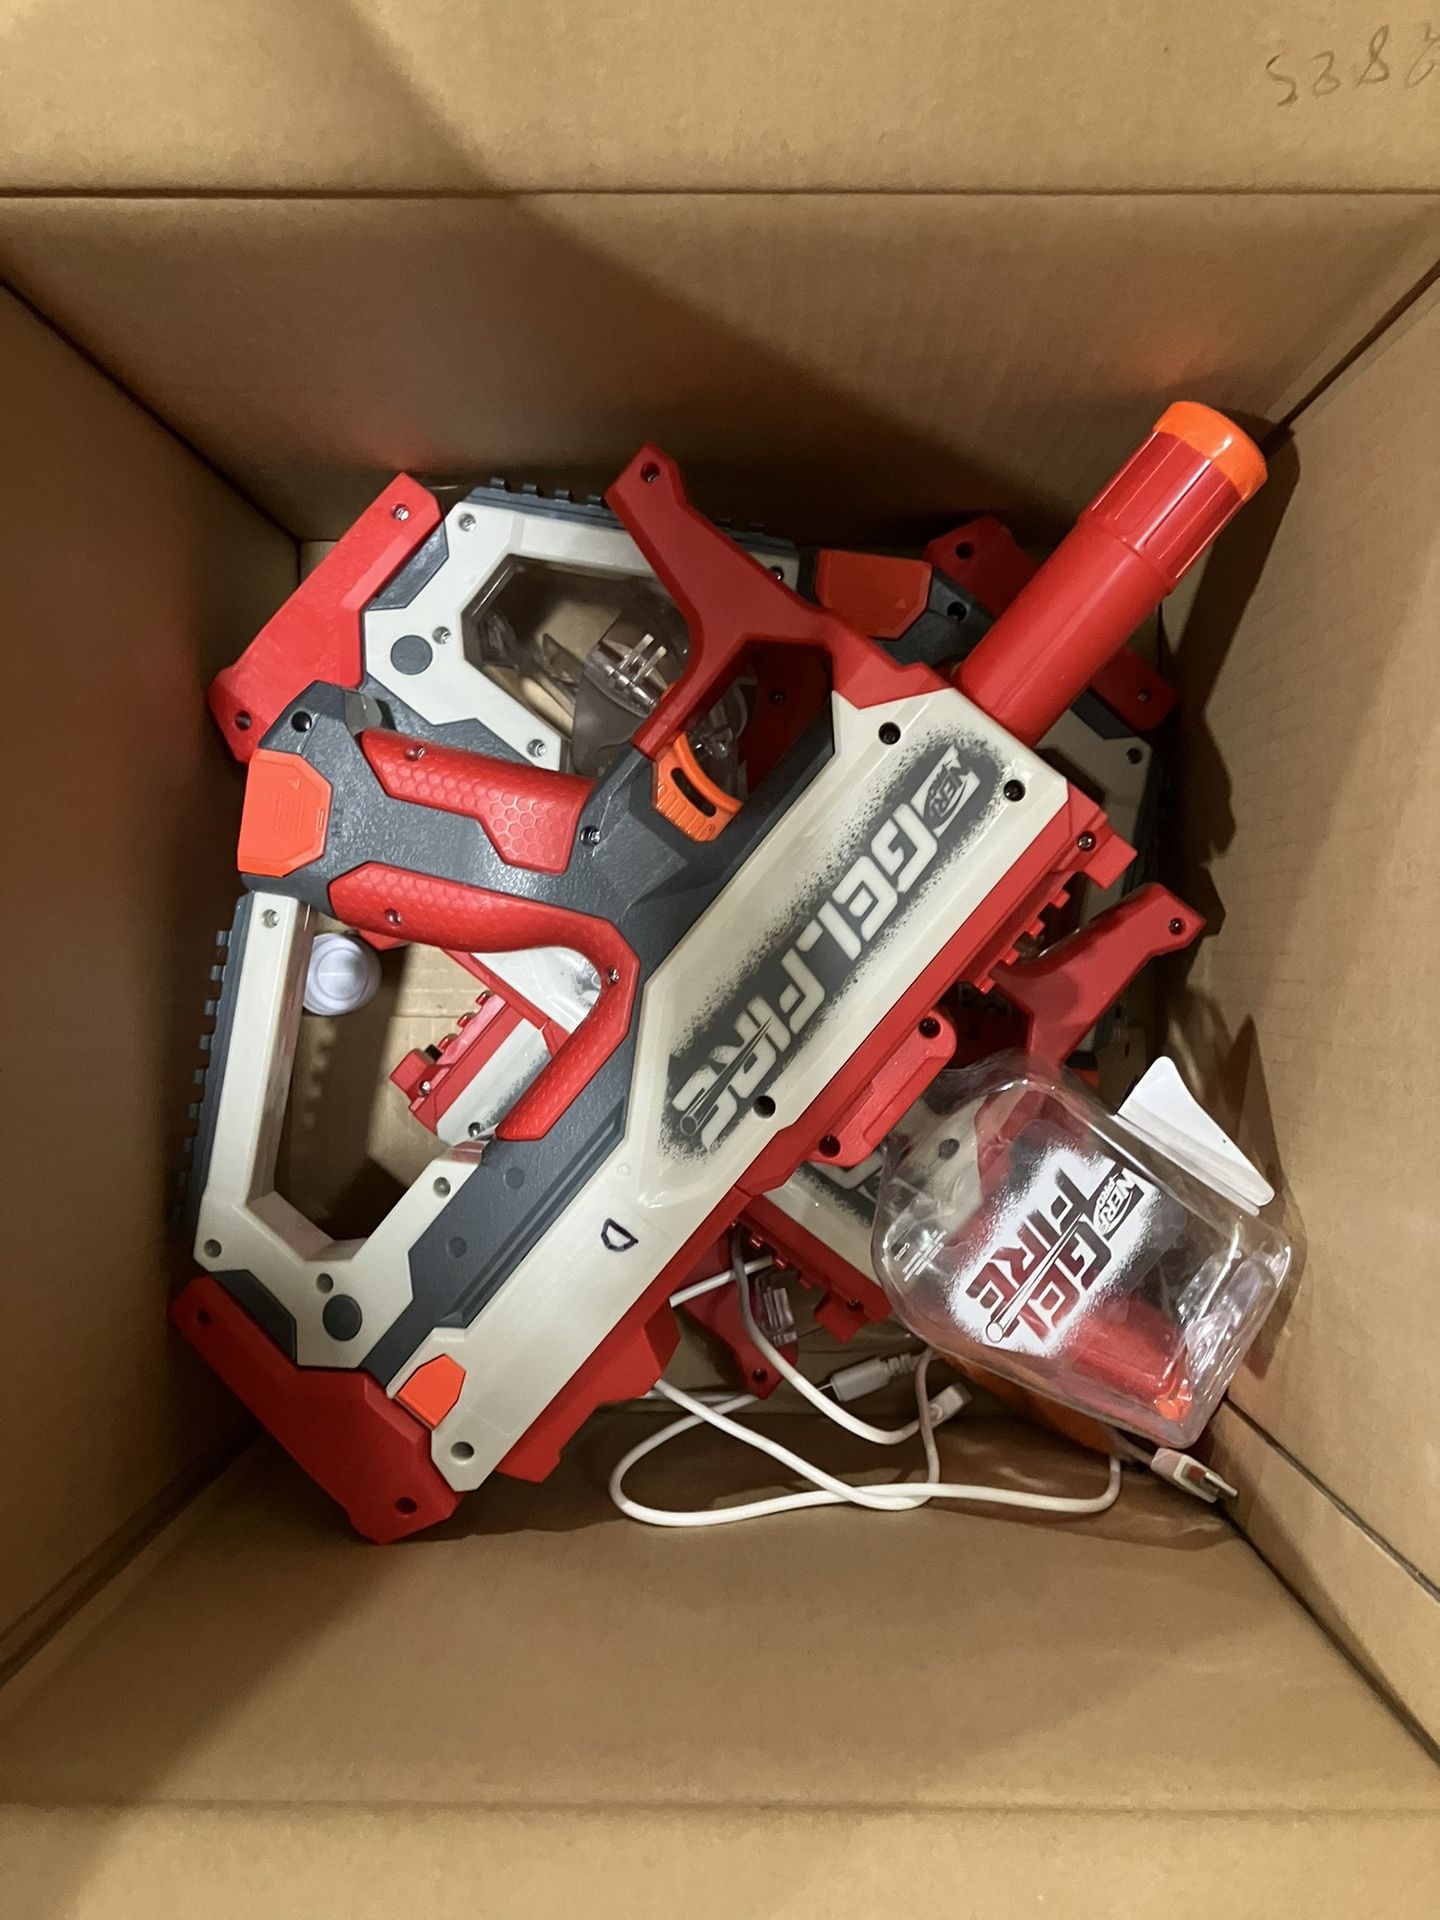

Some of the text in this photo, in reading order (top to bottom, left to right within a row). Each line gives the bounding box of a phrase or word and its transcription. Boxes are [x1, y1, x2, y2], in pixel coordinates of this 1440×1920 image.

[965, 1167, 1092, 1324] FIRE
[1099, 1170, 1136, 1236] NERF
[1002, 1219, 1113, 1342] GEL
